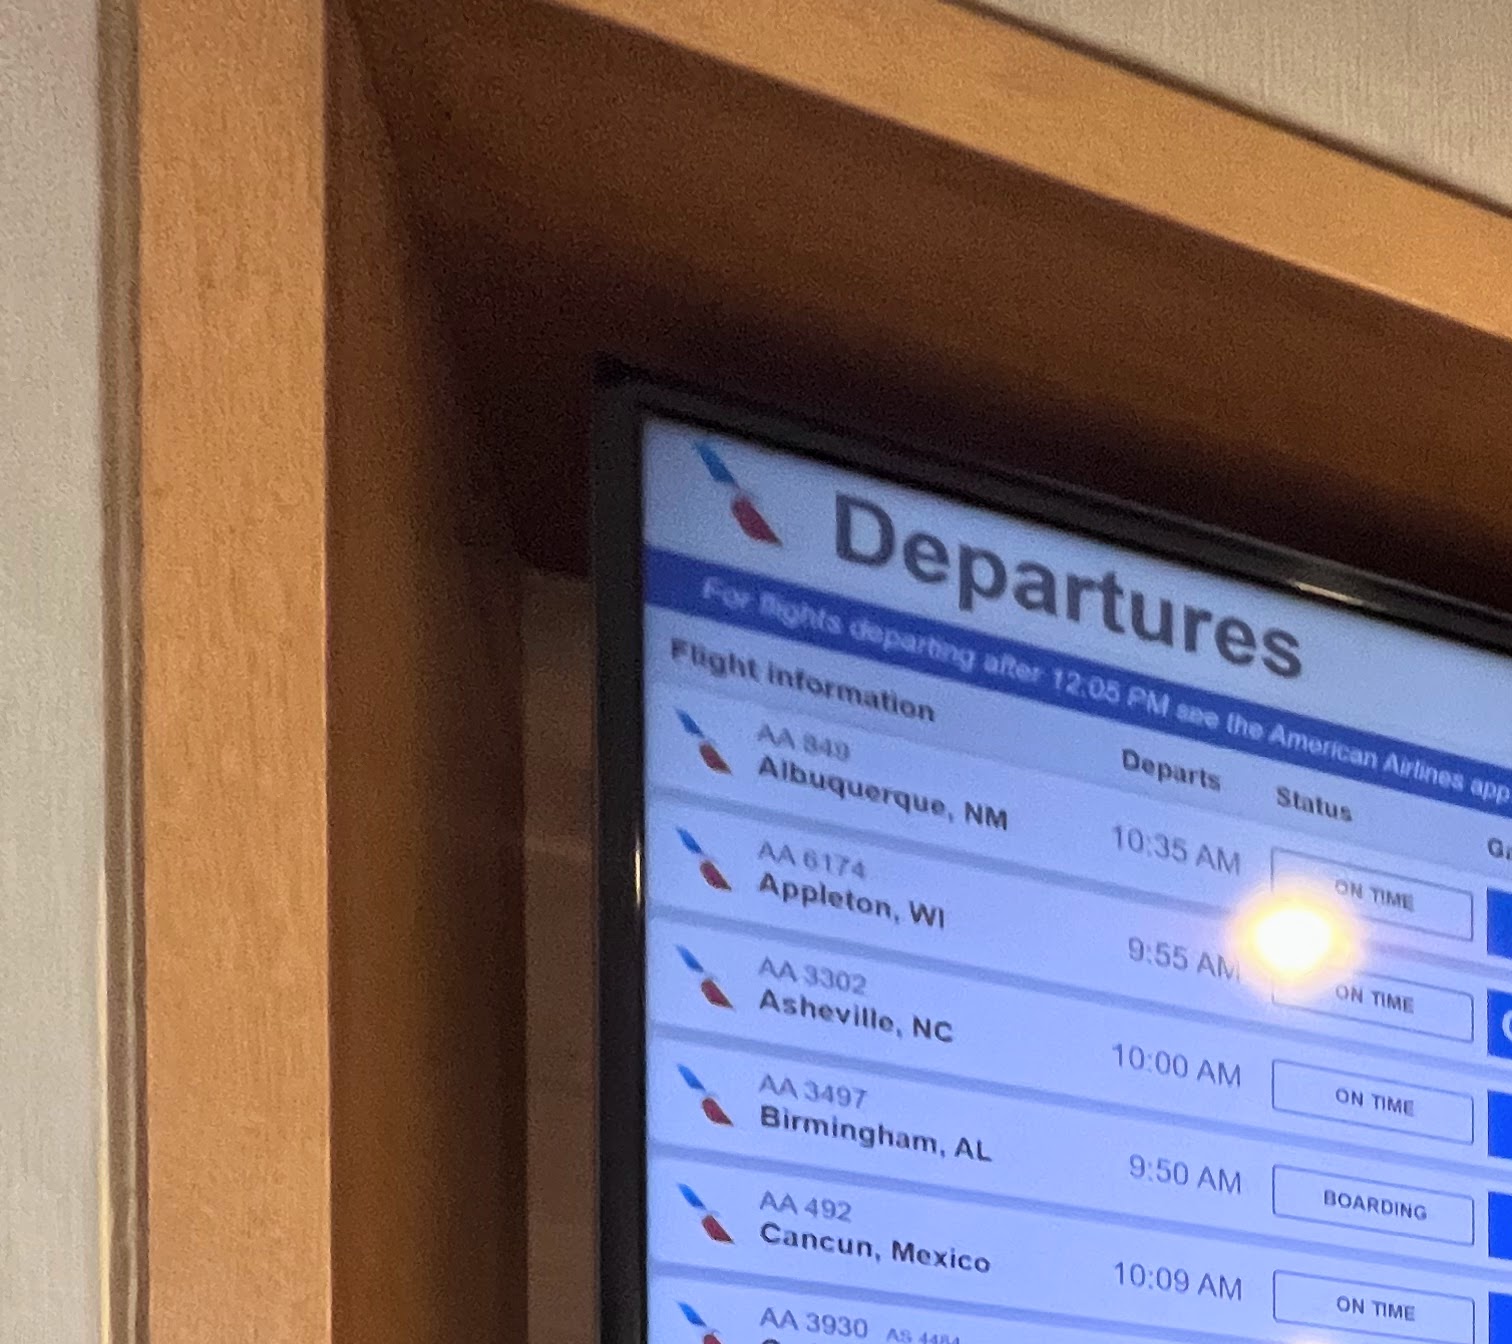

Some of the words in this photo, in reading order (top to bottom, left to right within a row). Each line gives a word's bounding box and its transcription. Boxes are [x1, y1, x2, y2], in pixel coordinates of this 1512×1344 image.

[834, 491, 1303, 678] Departures
[671, 637, 759, 680] Flight
[768, 660, 935, 722] information
[703, 575, 749, 610] For
[759, 592, 841, 632] flights
[849, 614, 977, 673] departing
[984, 653, 1041, 684] after
[1053, 664, 1121, 711] 12:05
[1126, 685, 1170, 718] PM
[1176, 702, 1219, 729] see
[1227, 710, 1263, 742] the
[1268, 724, 1378, 771] American
[1383, 753, 1464, 795] Airlines
[1469, 775, 1512, 805] app.
[758, 723, 796, 751] AA
[1122, 748, 1221, 791] Departs
[759, 755, 954, 823] Albuquerque,
[964, 800, 1008, 831] NM
[1276, 785, 1352, 823] Status
[759, 840, 796, 867] AA
[803, 849, 866, 879] 6174
[1113, 825, 1188, 863] 10:35
[1196, 844, 1241, 877] AM
[759, 872, 899, 924] Appleton,
[909, 900, 945, 929] WI
[759, 955, 797, 983] AA
[805, 967, 867, 996] 3302
[759, 988, 904, 1038] Asheville,
[912, 1015, 953, 1043] NC
[1113, 1043, 1188, 1080] 10:00
[1197, 1058, 1242, 1089] AM
[759, 1073, 798, 1100] AA
[805, 1081, 868, 1110] 3497
[1335, 1087, 1364, 1108] ON
[1372, 1094, 1415, 1117] TIME
[760, 1104, 946, 1158] Birmingham,
[954, 1137, 992, 1163] AL
[1129, 1153, 1188, 1187] 9:50
[1197, 1166, 1242, 1195] AM
[760, 1190, 797, 1217] AA
[805, 1198, 853, 1223] 492
[1323, 1188, 1428, 1223] BOARDING
[760, 1221, 881, 1263] Cancun,
[892, 1239, 991, 1274] Mexico
[1114, 1261, 1189, 1294] 10:09
[1198, 1274, 1243, 1302] AM
[760, 1306, 798, 1331] AA
[806, 1311, 869, 1339] 3930
[1336, 1295, 1365, 1316] ON
[1372, 1301, 1416, 1323] TIME
